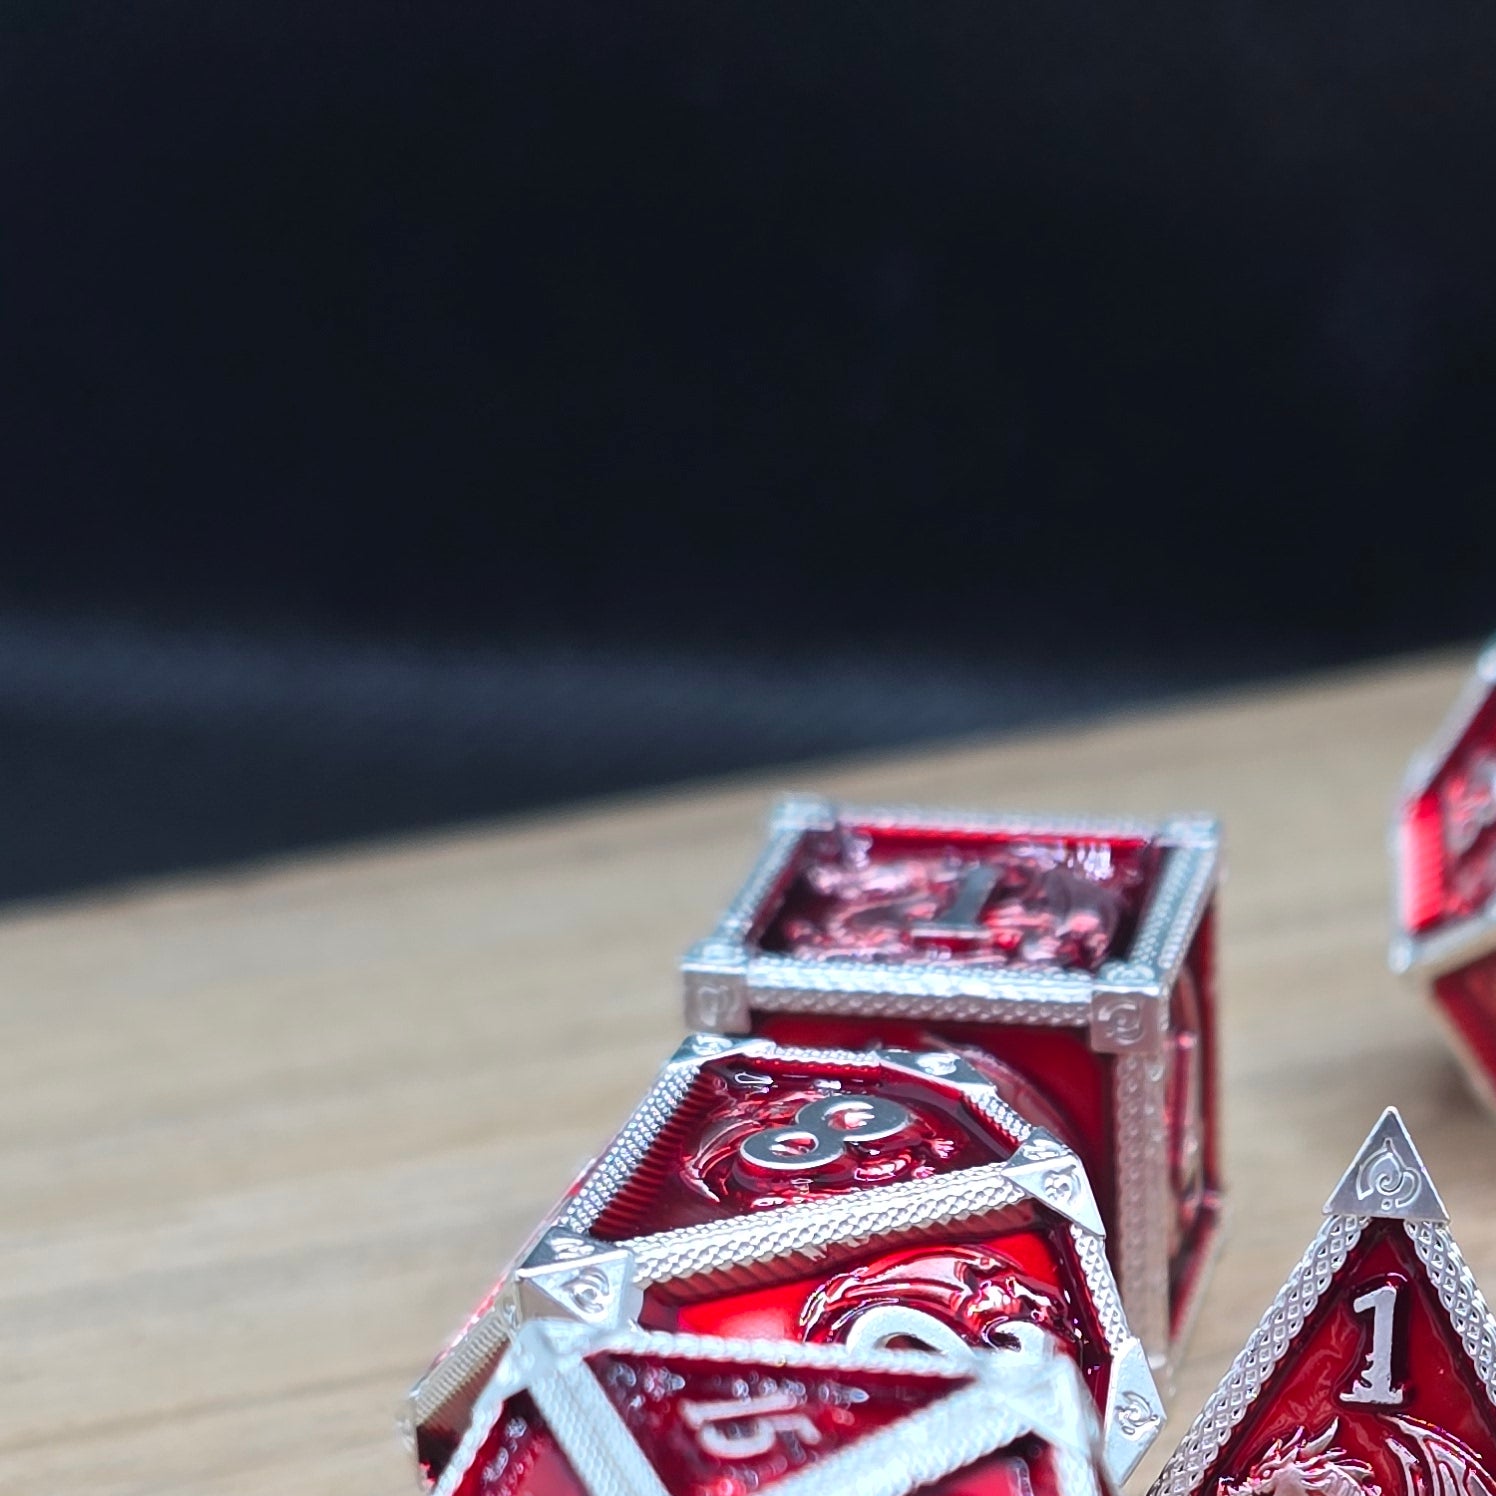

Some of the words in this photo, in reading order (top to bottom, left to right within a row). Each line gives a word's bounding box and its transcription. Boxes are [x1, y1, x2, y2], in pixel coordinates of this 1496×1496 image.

[741, 1096, 908, 1169] 8
[1340, 1286, 1404, 1404] 1
[680, 1395, 824, 1462] 15
